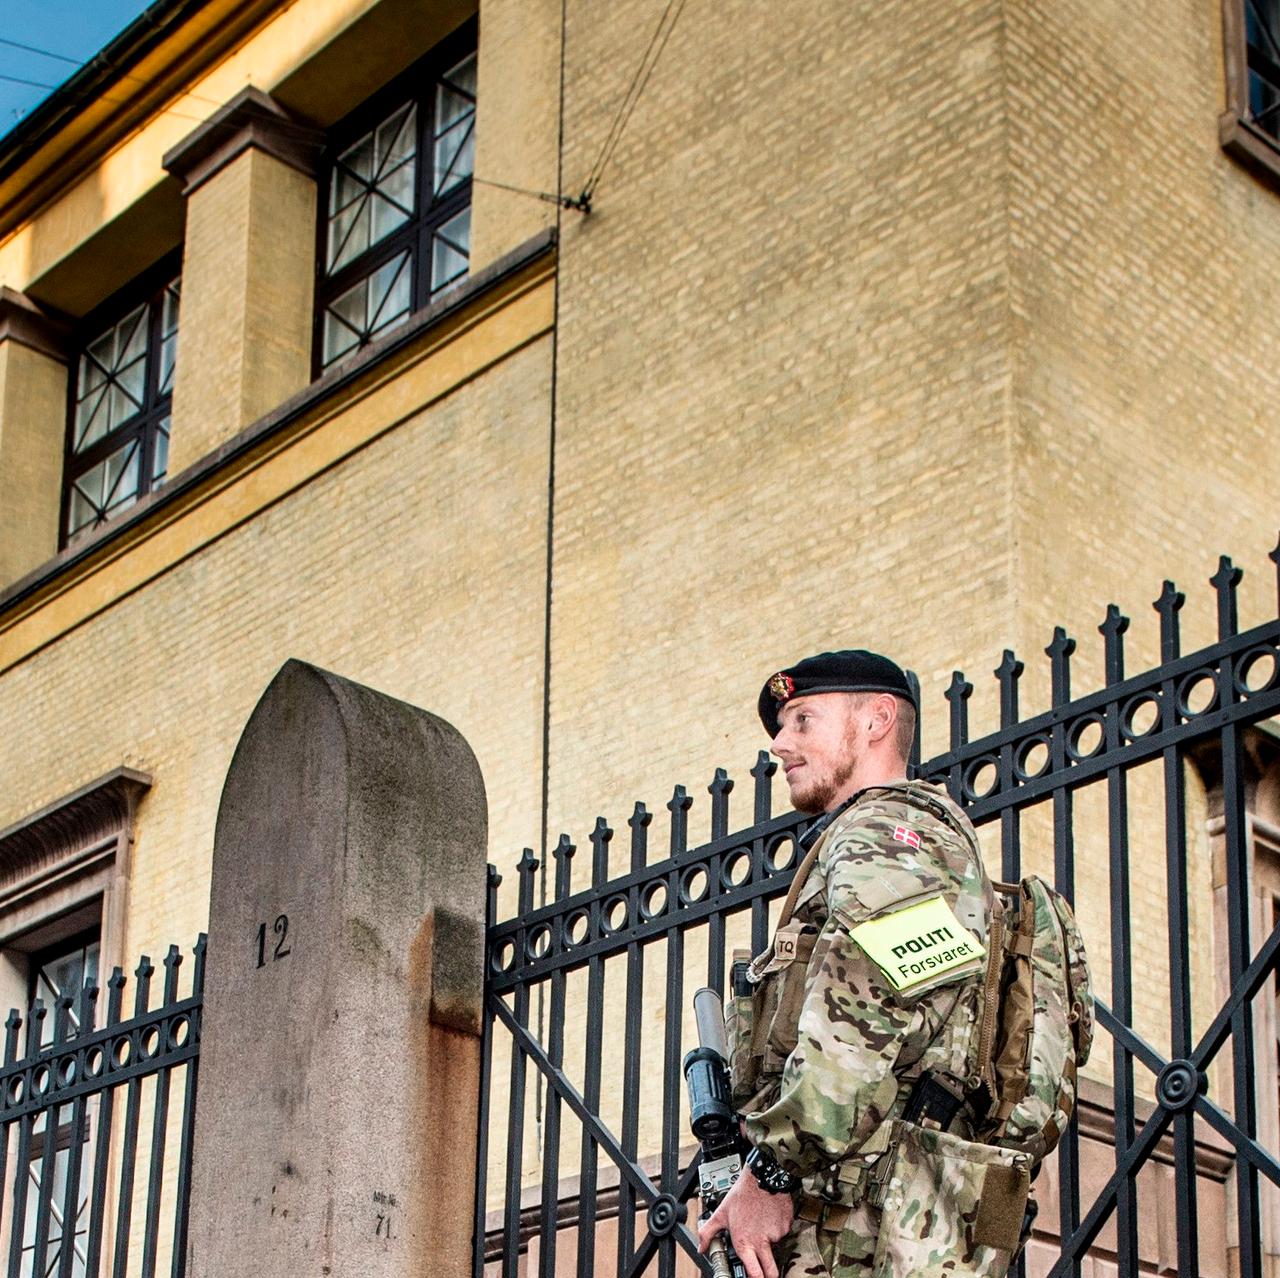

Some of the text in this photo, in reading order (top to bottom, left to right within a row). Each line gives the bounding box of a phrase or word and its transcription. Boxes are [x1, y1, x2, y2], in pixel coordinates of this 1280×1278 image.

[255, 914, 291, 969] 12
[778, 940, 794, 954] TQ
[891, 926, 954, 959] POLITI
[898, 941, 974, 979] Forsvaret
